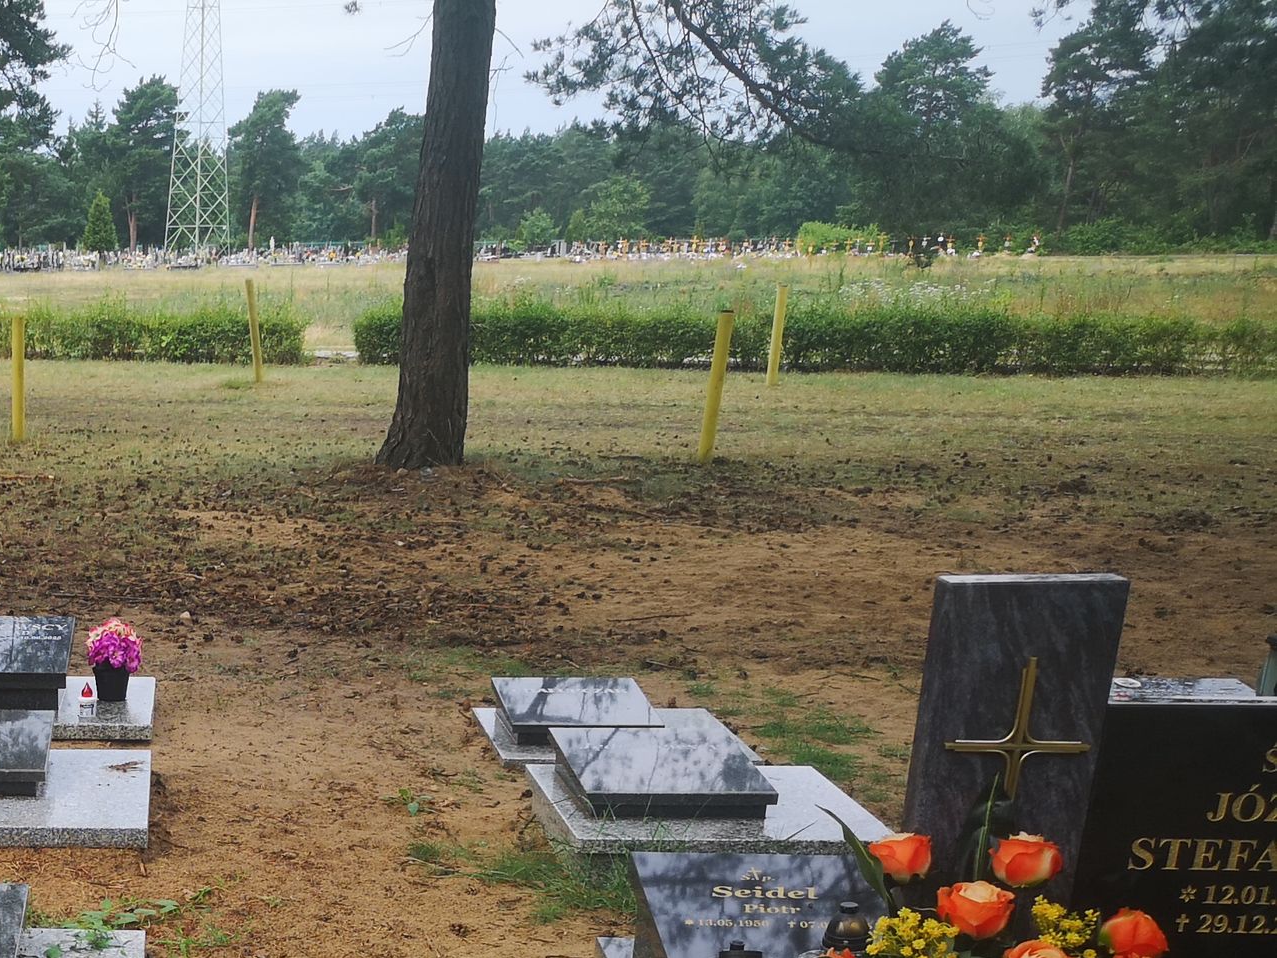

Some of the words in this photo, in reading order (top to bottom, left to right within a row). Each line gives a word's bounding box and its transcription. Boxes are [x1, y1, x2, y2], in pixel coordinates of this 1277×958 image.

[712, 885, 819, 900] Seidel
[743, 903, 801, 914] Piotr
[1196, 913, 1277, 934] 29.12.
